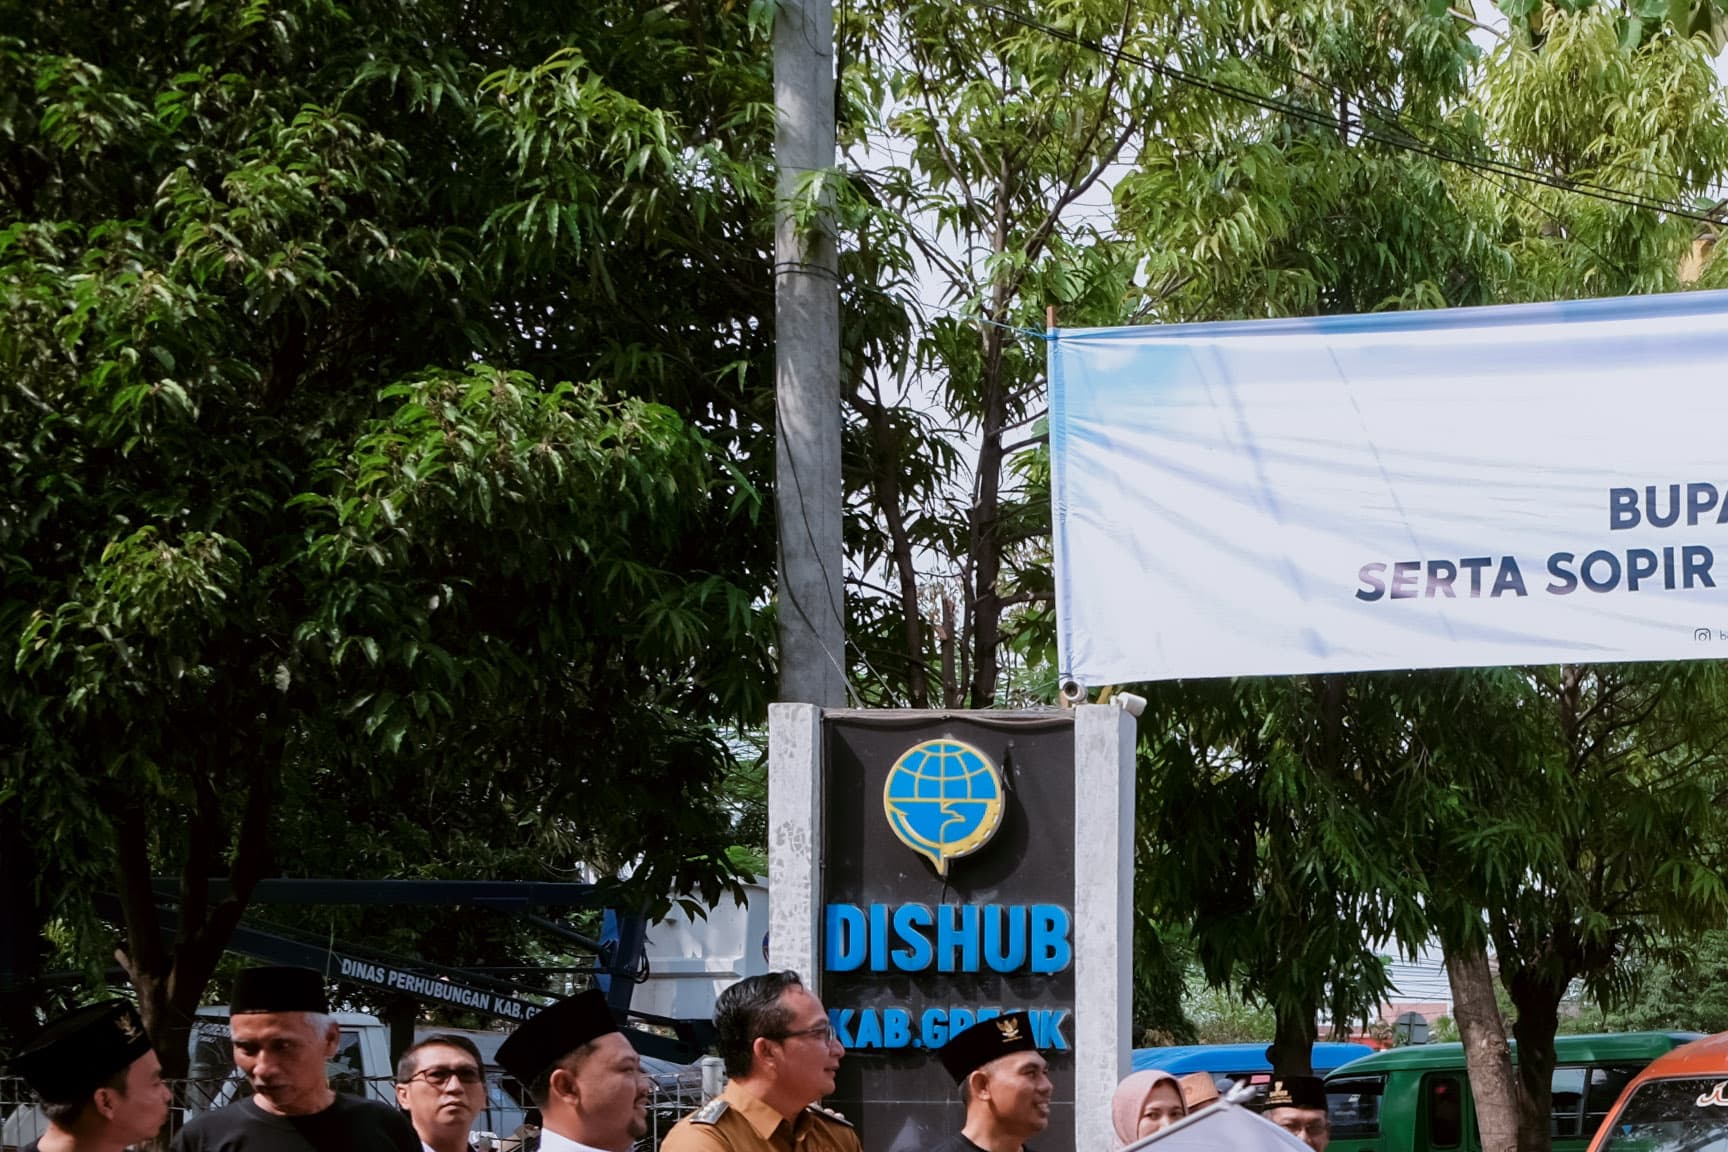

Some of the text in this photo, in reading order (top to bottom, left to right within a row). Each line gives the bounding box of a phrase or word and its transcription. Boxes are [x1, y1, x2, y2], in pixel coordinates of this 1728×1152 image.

[1354, 555, 1529, 602] SERTA
[1545, 545, 1717, 595] SOPIR
[826, 902, 1073, 974] DISHUB
[340, 957, 386, 984] DINAS
[387, 969, 491, 1010] PERHUBUNGAN
[493, 997, 525, 1020] KAB.
